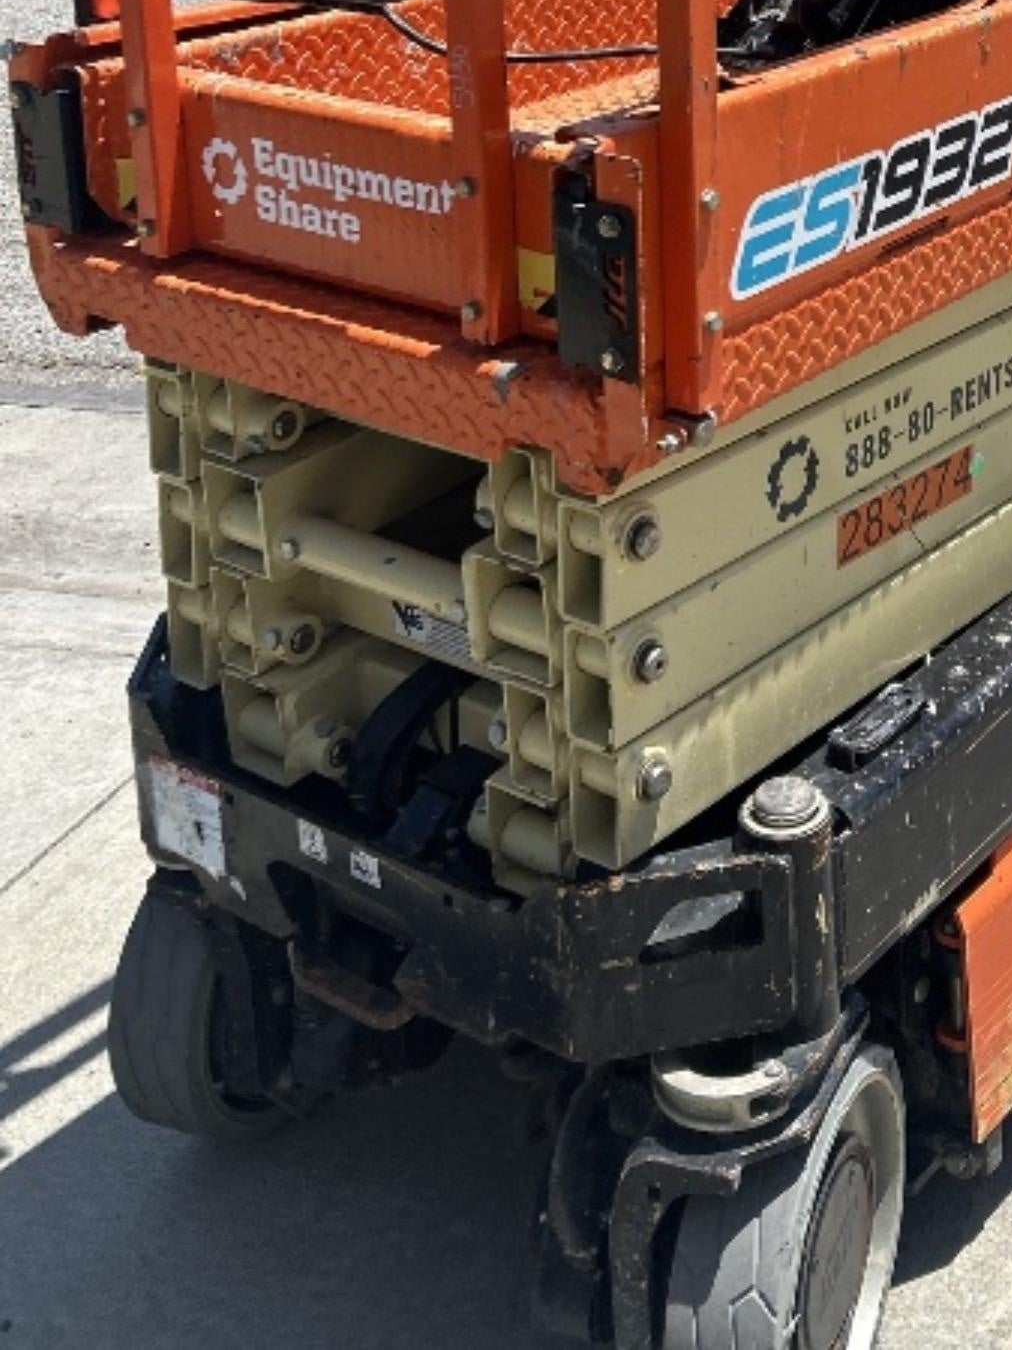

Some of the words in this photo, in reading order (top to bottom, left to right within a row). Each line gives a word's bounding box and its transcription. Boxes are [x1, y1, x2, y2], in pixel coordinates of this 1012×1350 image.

[250, 137, 455, 214] Equipment
[255, 183, 360, 242] Share
[840, 445, 971, 566] 283274
